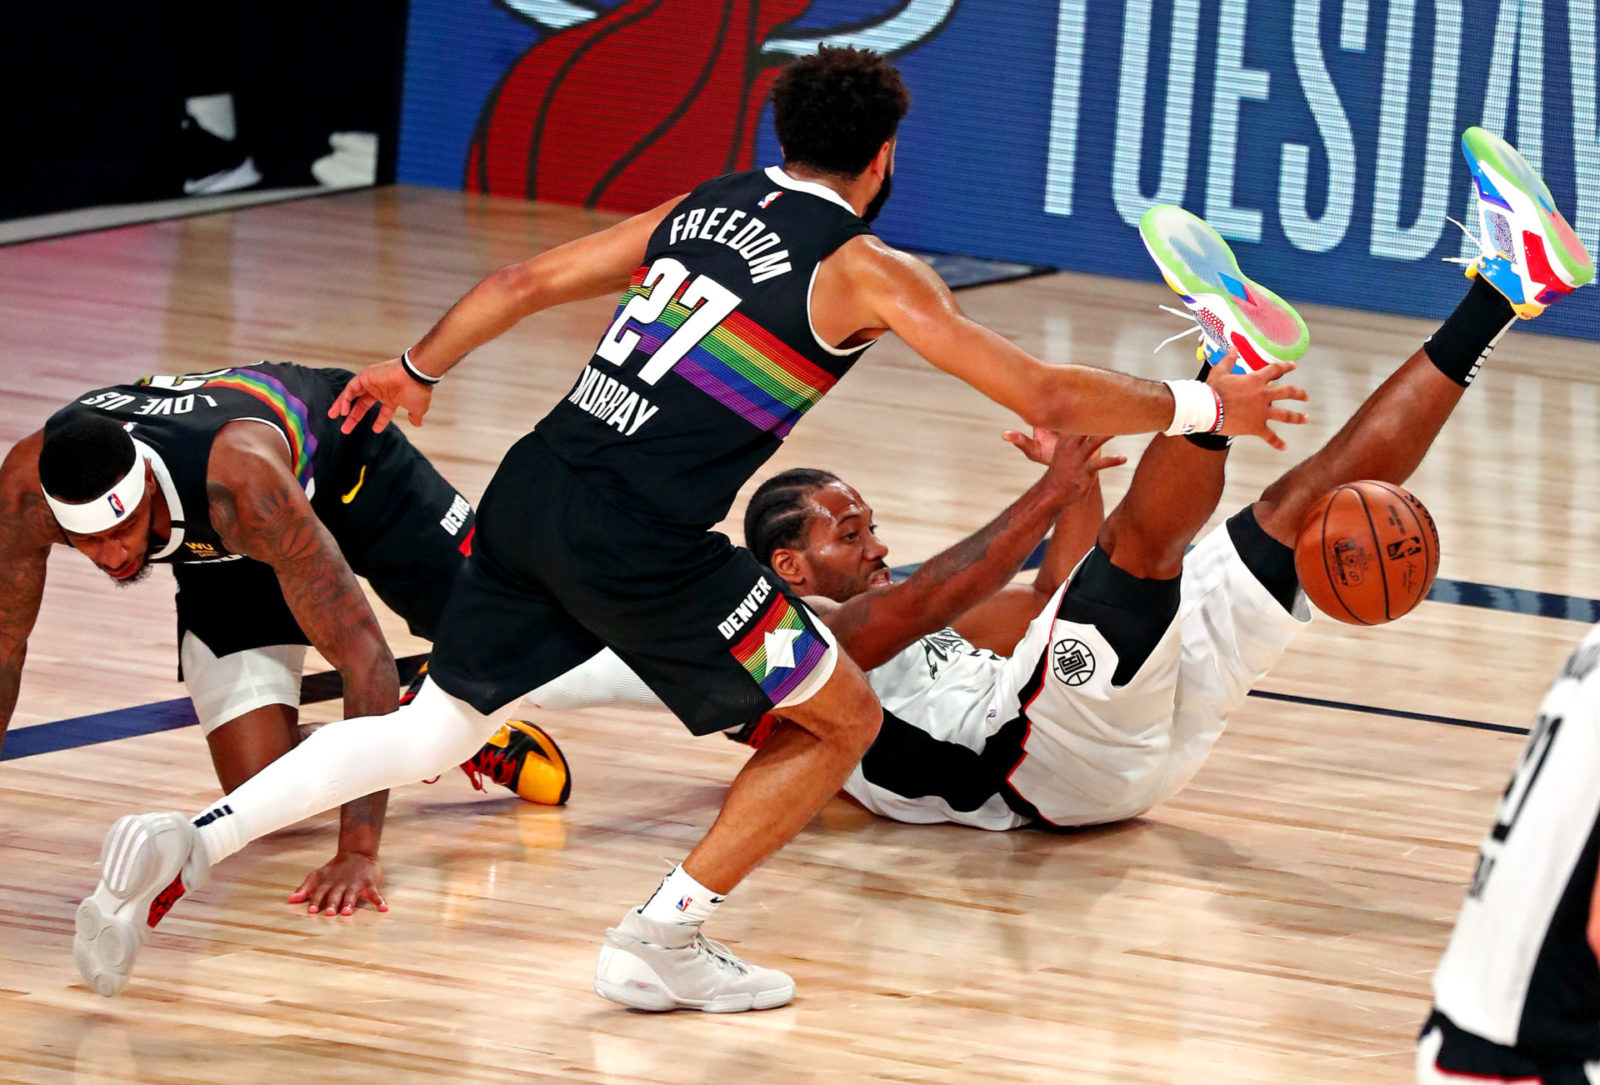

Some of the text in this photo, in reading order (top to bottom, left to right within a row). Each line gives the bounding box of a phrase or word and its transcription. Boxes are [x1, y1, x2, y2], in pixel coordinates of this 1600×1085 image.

[668, 207, 792, 284] FREEDOM
[596, 257, 743, 387] 27
[80, 391, 219, 416] LOVE US
[568, 365, 659, 437] MURRAY
[184, 541, 215, 551] WU
[717, 575, 772, 640] DENVER
